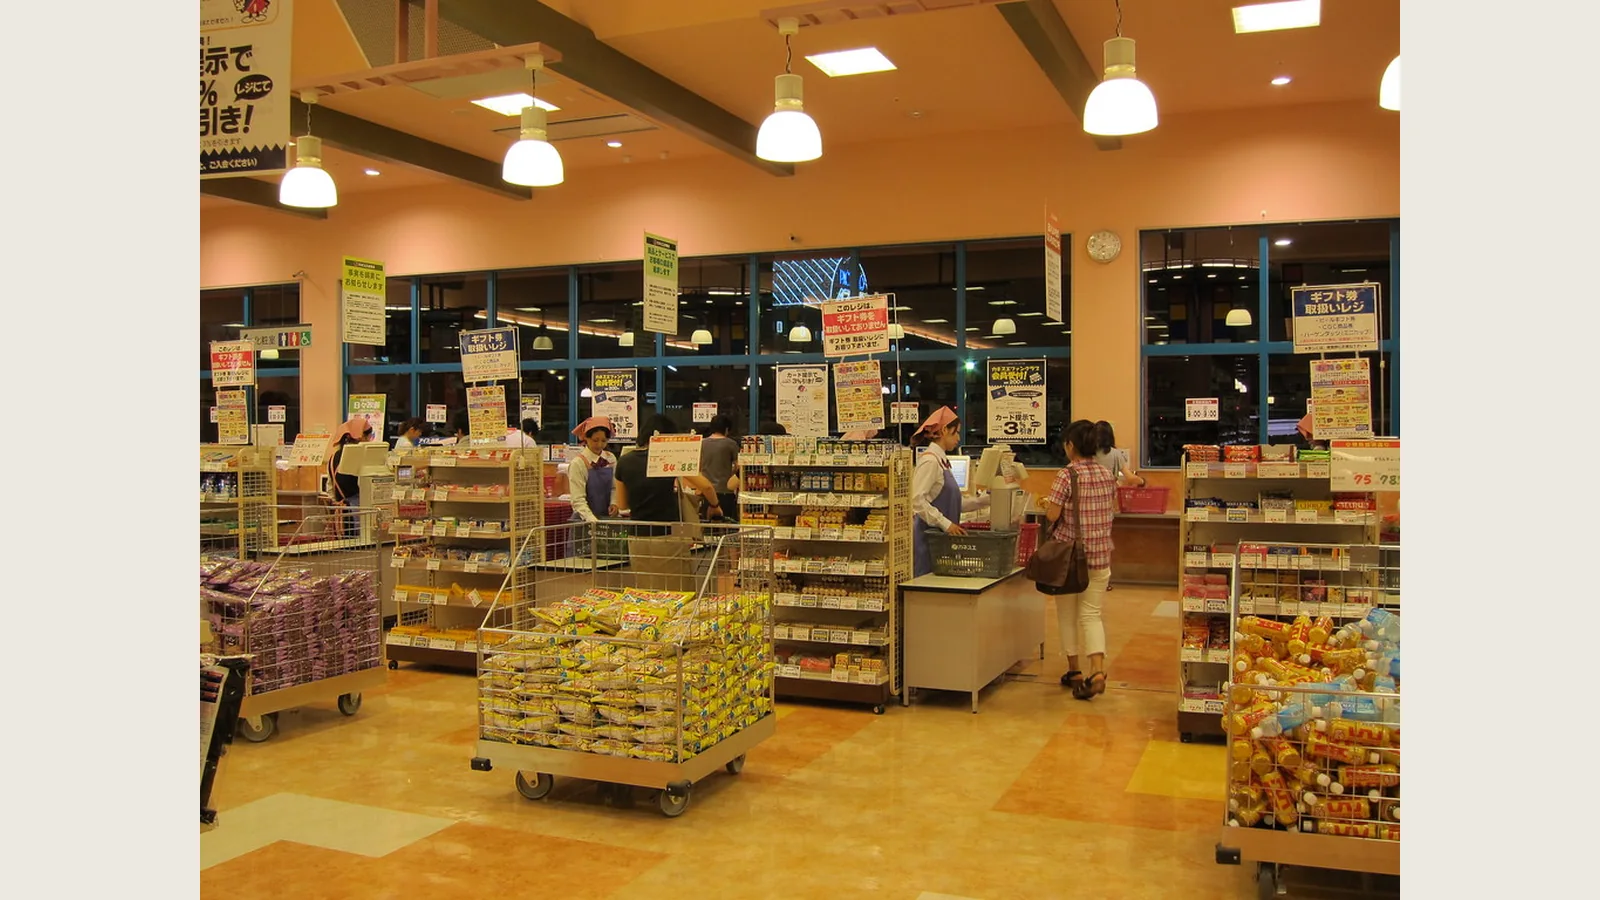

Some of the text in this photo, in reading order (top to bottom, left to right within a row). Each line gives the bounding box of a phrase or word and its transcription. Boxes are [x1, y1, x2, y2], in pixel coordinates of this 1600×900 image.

[237, 80, 271, 95] レジにて
[1310, 290, 1358, 303] ギフト券
[837, 302, 874, 312] このレジは、
[1305, 301, 1365, 315] 取扱いレジ
[471, 333, 504, 344] ギフト券
[468, 341, 507, 353] 取扱いレジ
[1005, 422, 1019, 435] 3
[680, 463, 693, 472] 88
[1354, 474, 1372, 485] 75
